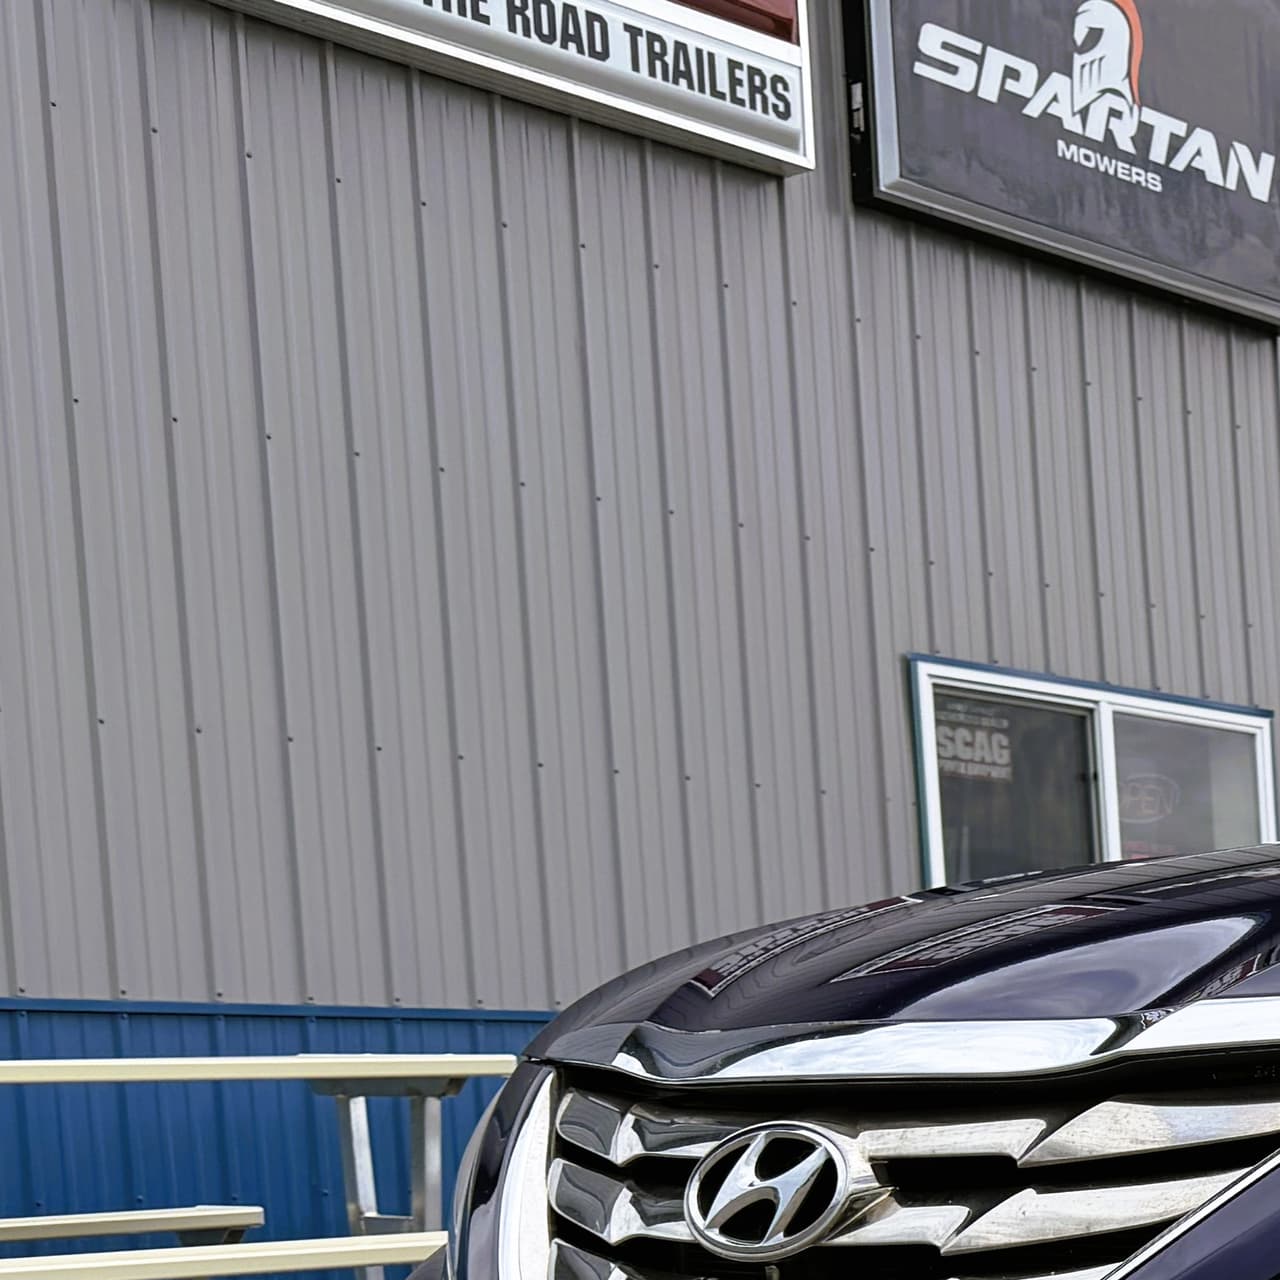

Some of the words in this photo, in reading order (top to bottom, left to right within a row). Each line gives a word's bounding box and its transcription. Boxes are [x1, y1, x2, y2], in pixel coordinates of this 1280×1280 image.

[506, 0, 610, 62] ROAD
[623, 27, 792, 121] TRAILERS
[913, 22, 1275, 203] SPARTAN
[1057, 140, 1163, 192] MOWERS
[936, 725, 1011, 765] SCAG
